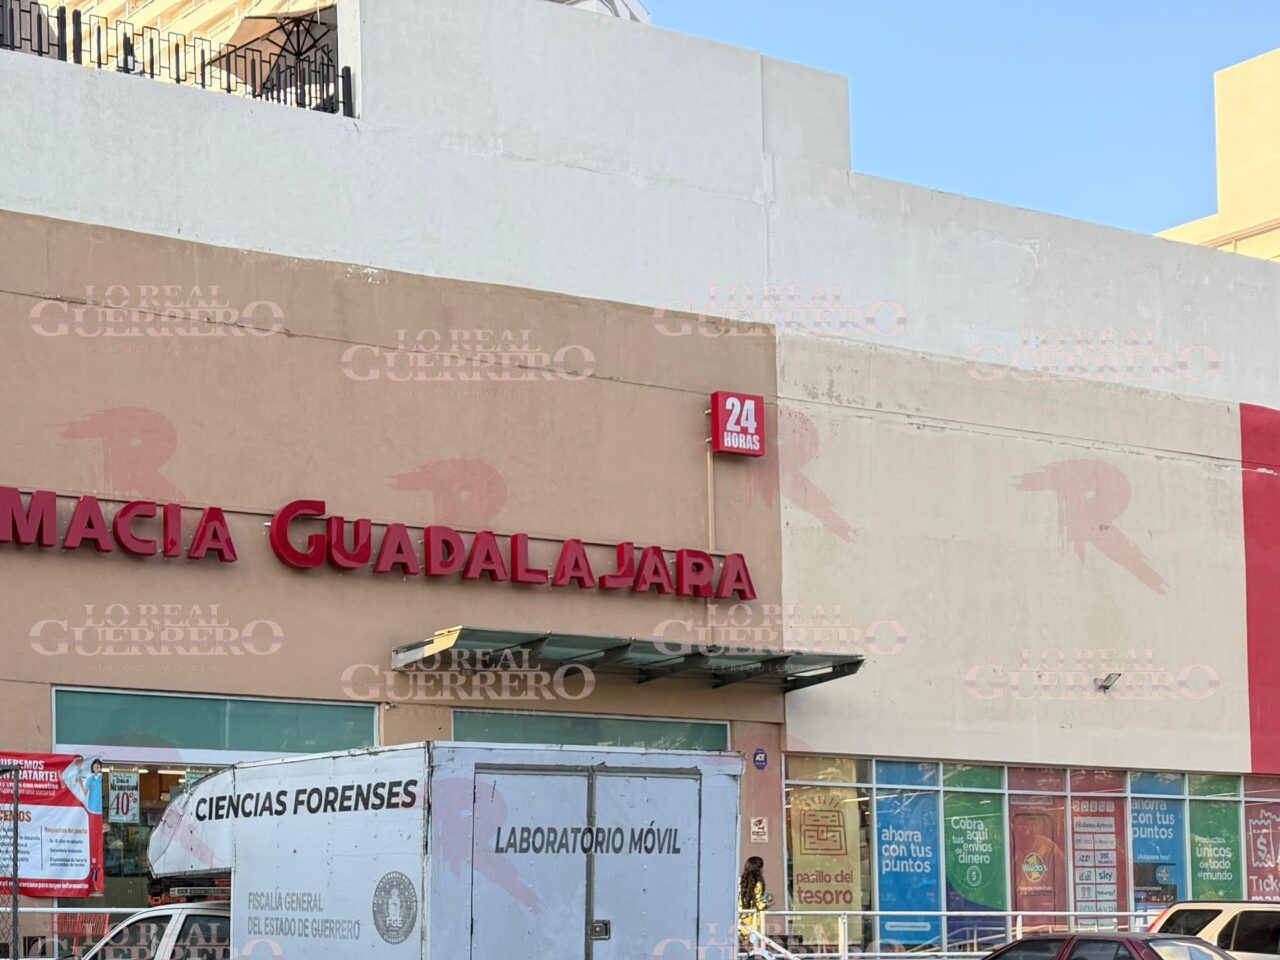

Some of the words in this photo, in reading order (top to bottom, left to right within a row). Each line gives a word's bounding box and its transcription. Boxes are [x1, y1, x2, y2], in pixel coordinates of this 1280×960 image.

[725, 396, 757, 434] 24
[723, 431, 761, 451] HORAS
[268, 500, 757, 600] GUADALAJARA
[195, 789, 288, 822] CIENCIAS
[293, 779, 418, 815] FORENSES
[951, 816, 984, 830] Cobra
[1131, 813, 1153, 824] con
[1156, 811, 1175, 824] tus
[494, 826, 624, 855] LABORATORIO
[628, 820, 681, 855] MÓVIL
[881, 826, 921, 843] ahorra
[881, 844, 907, 858] con
[910, 842, 932, 858] tus
[958, 851, 991, 864] dinero
[1195, 844, 1233, 858] únicos
[881, 858, 931, 875] puntos
[1209, 858, 1231, 869] todo
[796, 871, 831, 886] pasillo
[834, 871, 853, 884] del
[1099, 871, 1114, 881] sky
[1203, 870, 1233, 880] mundo
[247, 886, 283, 911] FISCALÍA
[284, 892, 324, 912] GENERAL
[796, 888, 853, 905] tesoro
[247, 916, 263, 935] DEL
[264, 917, 295, 937] ESTADO
[297, 918, 309, 937] DE
[311, 918, 360, 940] GUERRERO
[386, 917, 403, 927] FGE
